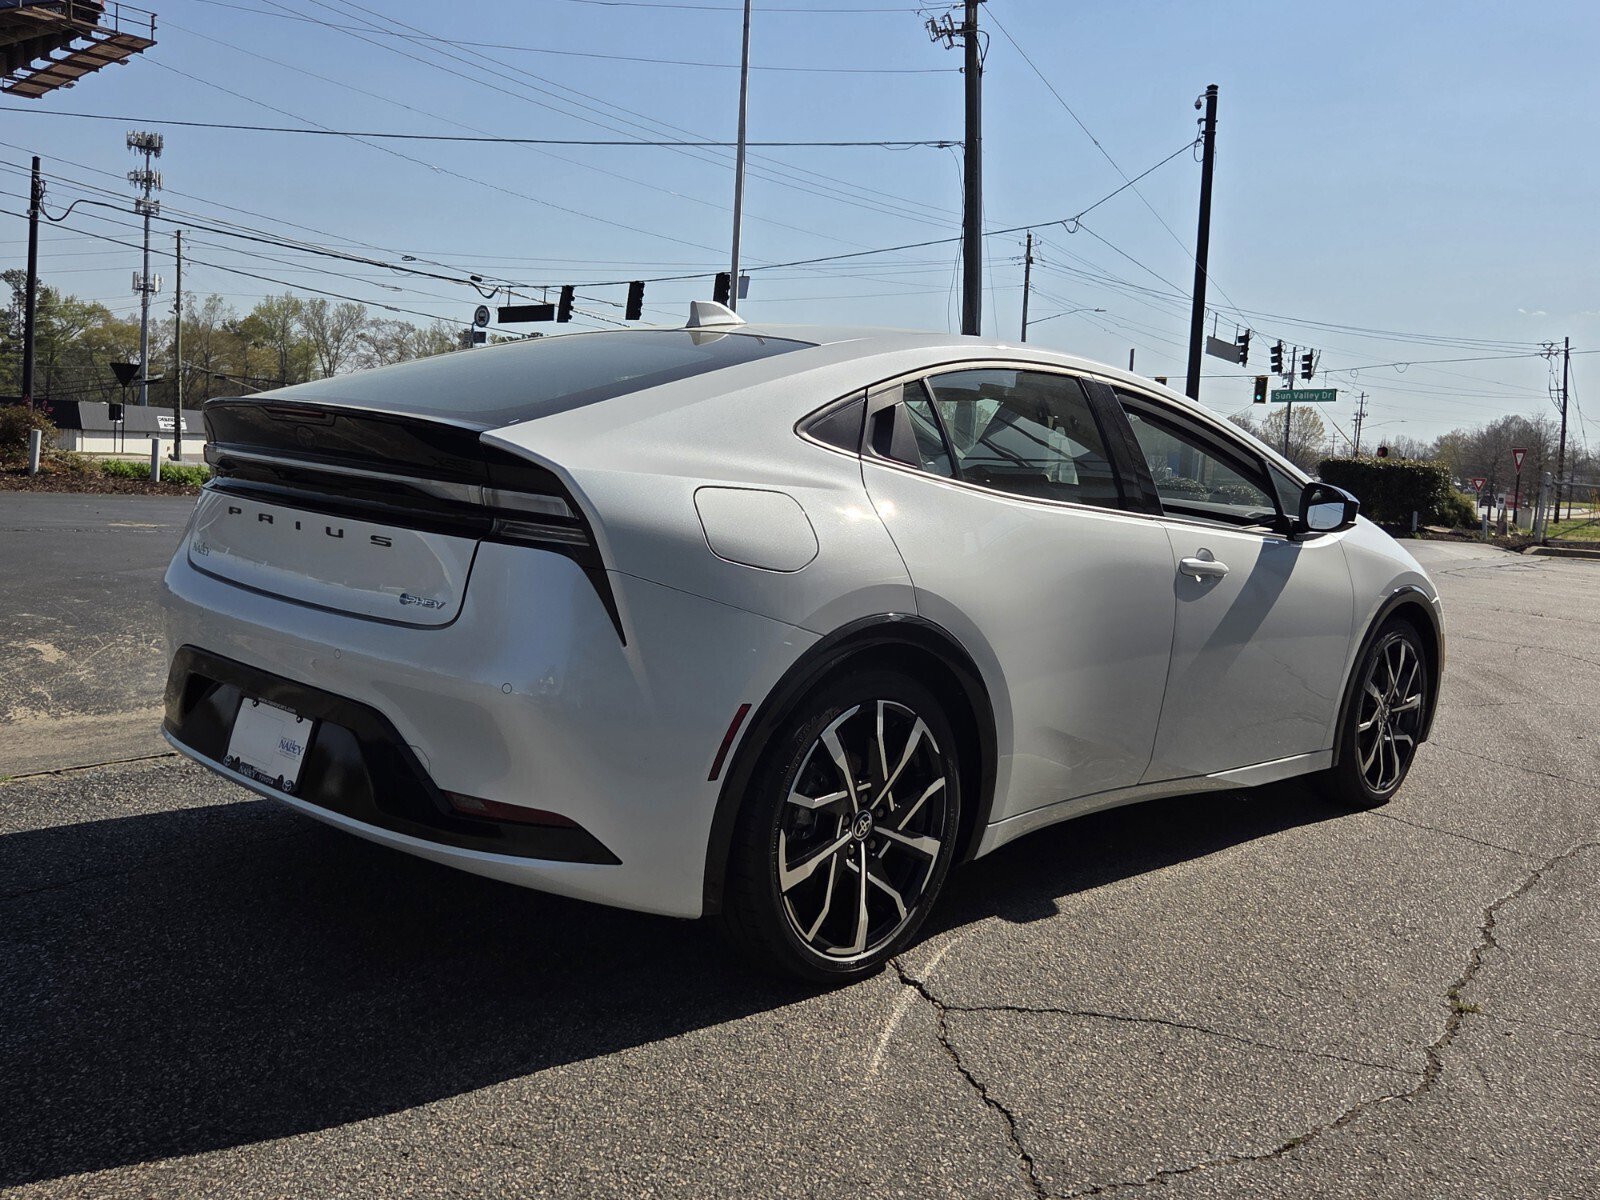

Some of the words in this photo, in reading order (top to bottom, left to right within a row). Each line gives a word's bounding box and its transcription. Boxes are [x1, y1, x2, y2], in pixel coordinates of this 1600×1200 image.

[1275, 391, 1291, 400] Sun
[1293, 391, 1320, 400] Valley
[1321, 391, 1333, 399] Dr
[228, 506, 392, 548] PRIUS
[278, 738, 305, 756] NALLEY
[258, 774, 274, 784] TOYOTA
